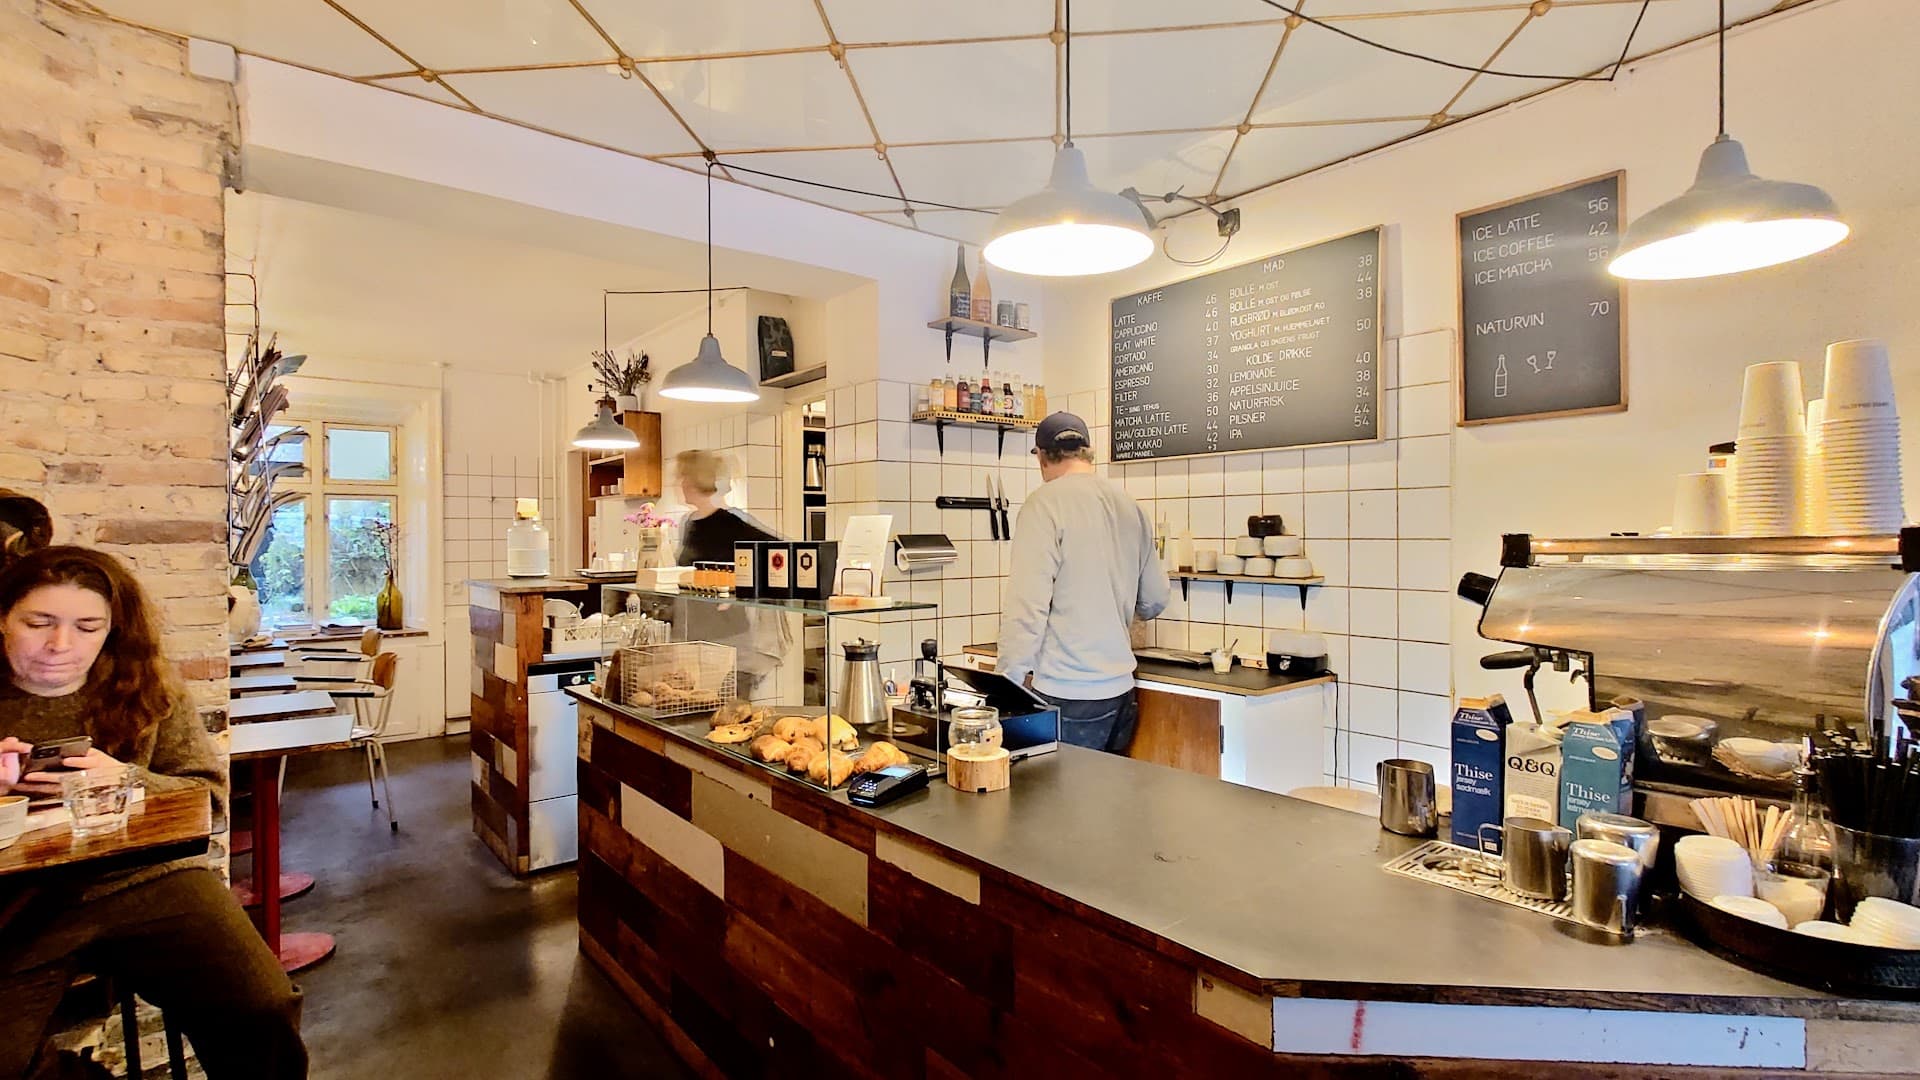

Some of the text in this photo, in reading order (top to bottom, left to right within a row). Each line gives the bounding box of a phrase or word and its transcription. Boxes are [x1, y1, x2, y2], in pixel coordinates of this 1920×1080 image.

[1588, 197, 1609, 214] 56
[1472, 213, 1541, 241] ICE LATTE
[1588, 222, 1609, 238] 42
[1473, 233, 1555, 263] ICE COFFEE
[1588, 247, 1609, 262] 56
[1263, 259, 1285, 273] MAD
[1358, 254, 1373, 268] 38
[1356, 271, 1372, 283] 44
[1474, 258, 1553, 286] ICE MATCHA
[1229, 283, 1255, 299] BOLLE
[1356, 287, 1373, 300] 38
[1137, 291, 1163, 306] KAFFE
[1205, 294, 1218, 305] 46
[1229, 297, 1256, 313] BOLLE
[1205, 307, 1218, 318] 46
[1589, 301, 1610, 317] 70
[1114, 313, 1136, 327] LATTE
[1230, 309, 1271, 328] RUGBRØD
[1356, 318, 1371, 331] 50
[1476, 312, 1545, 336] NATURVIN
[1114, 322, 1158, 339] CAPPUCCINO
[1205, 321, 1219, 332] 40
[1230, 323, 1272, 341] YOGHURT
[1114, 335, 1157, 352] FLAT WHITE
[1206, 335, 1219, 347] 37
[1230, 342, 1259, 353] GRANOLA
[1114, 350, 1147, 365] CORTADO
[1207, 350, 1219, 361] 34
[1246, 346, 1313, 366] KOLDE DRIKKE
[1356, 351, 1371, 364] 40
[1114, 361, 1154, 377] AMERICANO
[1207, 364, 1219, 375] 30
[1229, 367, 1277, 383] LEMONADE
[1356, 369, 1371, 382] 38
[1114, 376, 1150, 390] ESPRESSO
[1206, 378, 1219, 389] 32
[1229, 379, 1300, 397] APPELSINJUICE
[1114, 390, 1138, 402] FILTER
[1207, 392, 1219, 403] 36
[1356, 386, 1370, 398] 34
[1143, 403, 1160, 411] TEHUS
[1229, 396, 1286, 411] NATURFRISK
[1354, 403, 1370, 416] 44
[1206, 405, 1219, 417] 50
[1115, 412, 1171, 427] MATCHA LATTE
[1206, 420, 1219, 430] 44
[1229, 412, 1266, 425] PILSNER
[1354, 416, 1370, 428] 54
[1115, 423, 1189, 440] CHAI/GOLDEN LATTE
[1206, 432, 1219, 443] 42
[1229, 429, 1243, 439] IPA
[1115, 438, 1163, 452] VARM KAKAO
[1458, 711, 1484, 721] Thise
[1572, 726, 1601, 738] Thise
[1454, 763, 1494, 781] Thise
[1507, 756, 1557, 777] Q&Q
[1565, 781, 1611, 803] Thise
